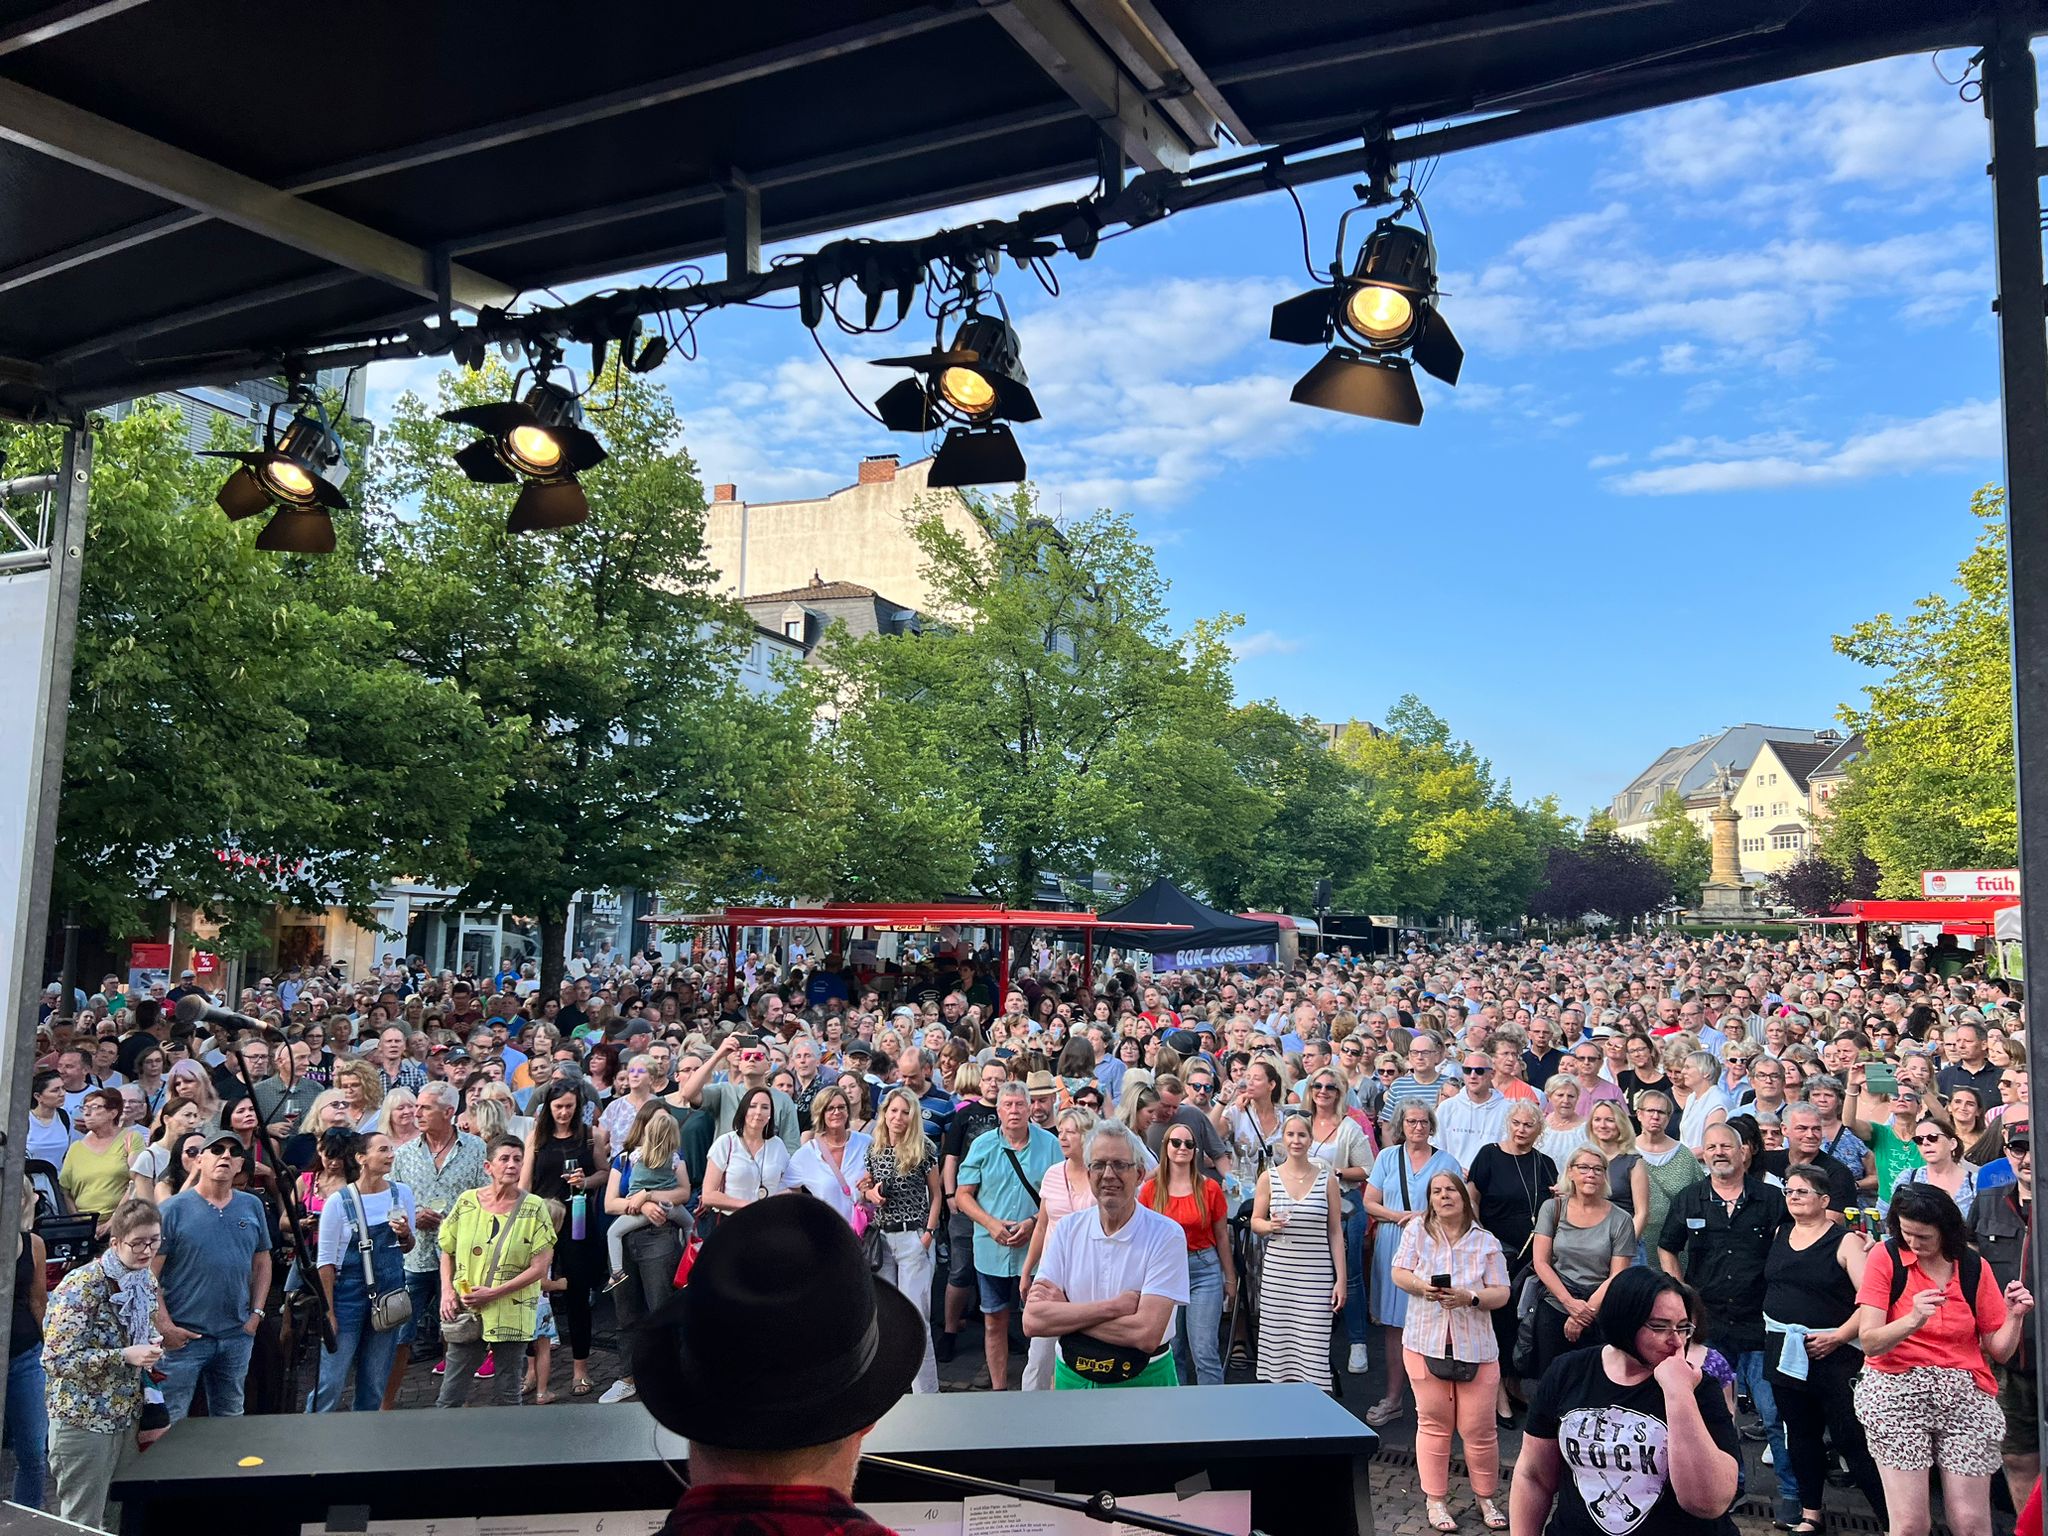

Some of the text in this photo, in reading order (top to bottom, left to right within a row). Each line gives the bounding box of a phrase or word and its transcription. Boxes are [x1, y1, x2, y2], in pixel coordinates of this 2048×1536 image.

[1176, 945, 1253, 967] BON-KASSE
[1578, 1417, 1647, 1443] LET'S
[1565, 1437, 1659, 1475] ROCK
[924, 1508, 939, 1520] 10
[595, 1518, 604, 1533] 6
